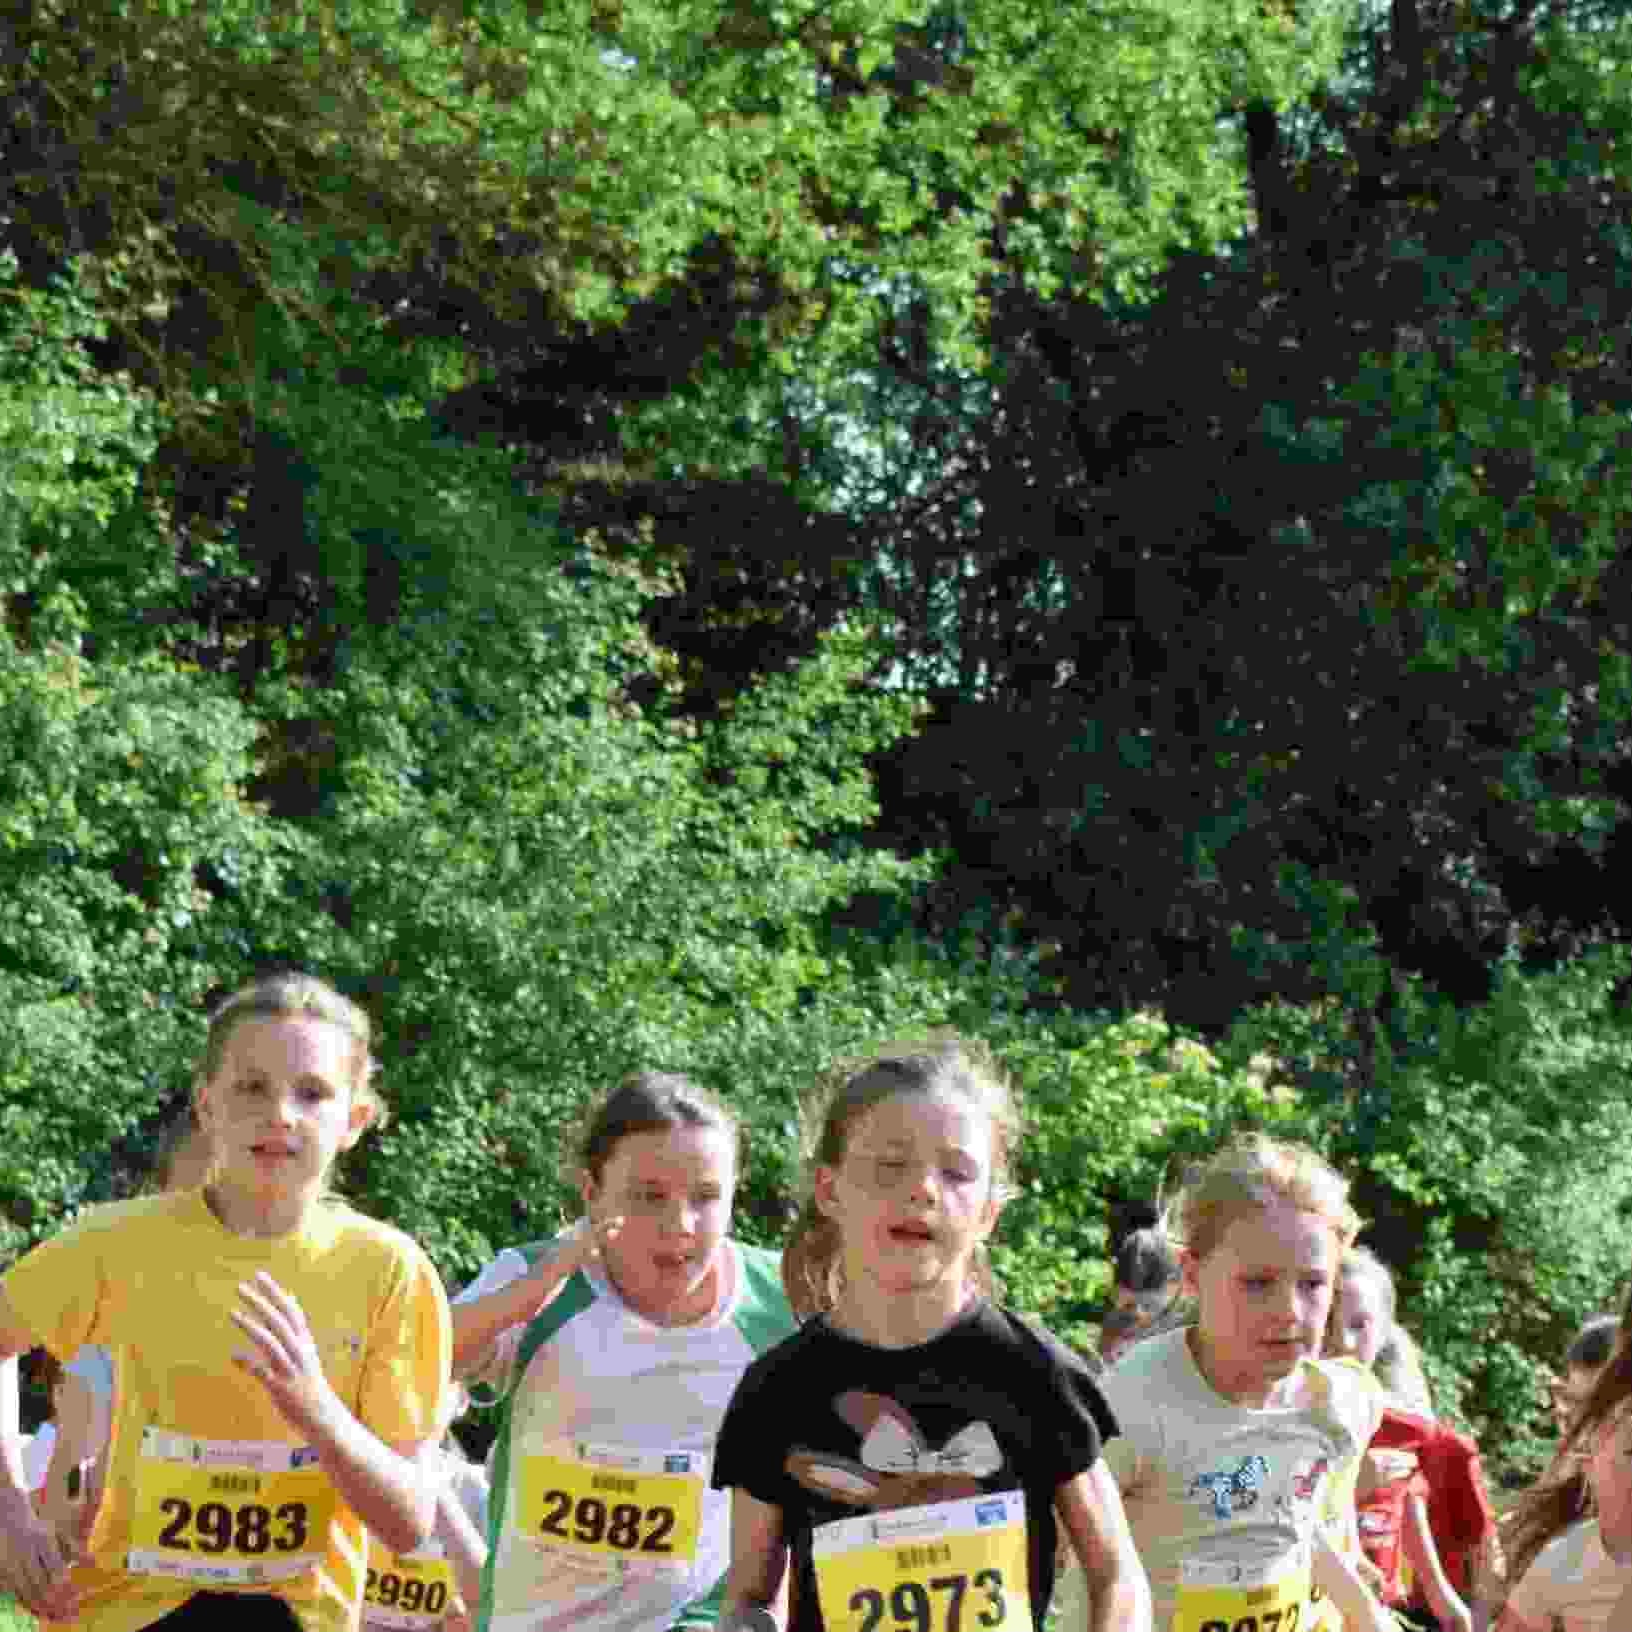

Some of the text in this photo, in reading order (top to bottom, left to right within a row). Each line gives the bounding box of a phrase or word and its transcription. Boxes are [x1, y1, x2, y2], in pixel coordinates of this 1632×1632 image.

[158, 1498, 307, 1554] 2983
[540, 1490, 675, 1552] 2982
[364, 1569, 448, 1615] 2990
